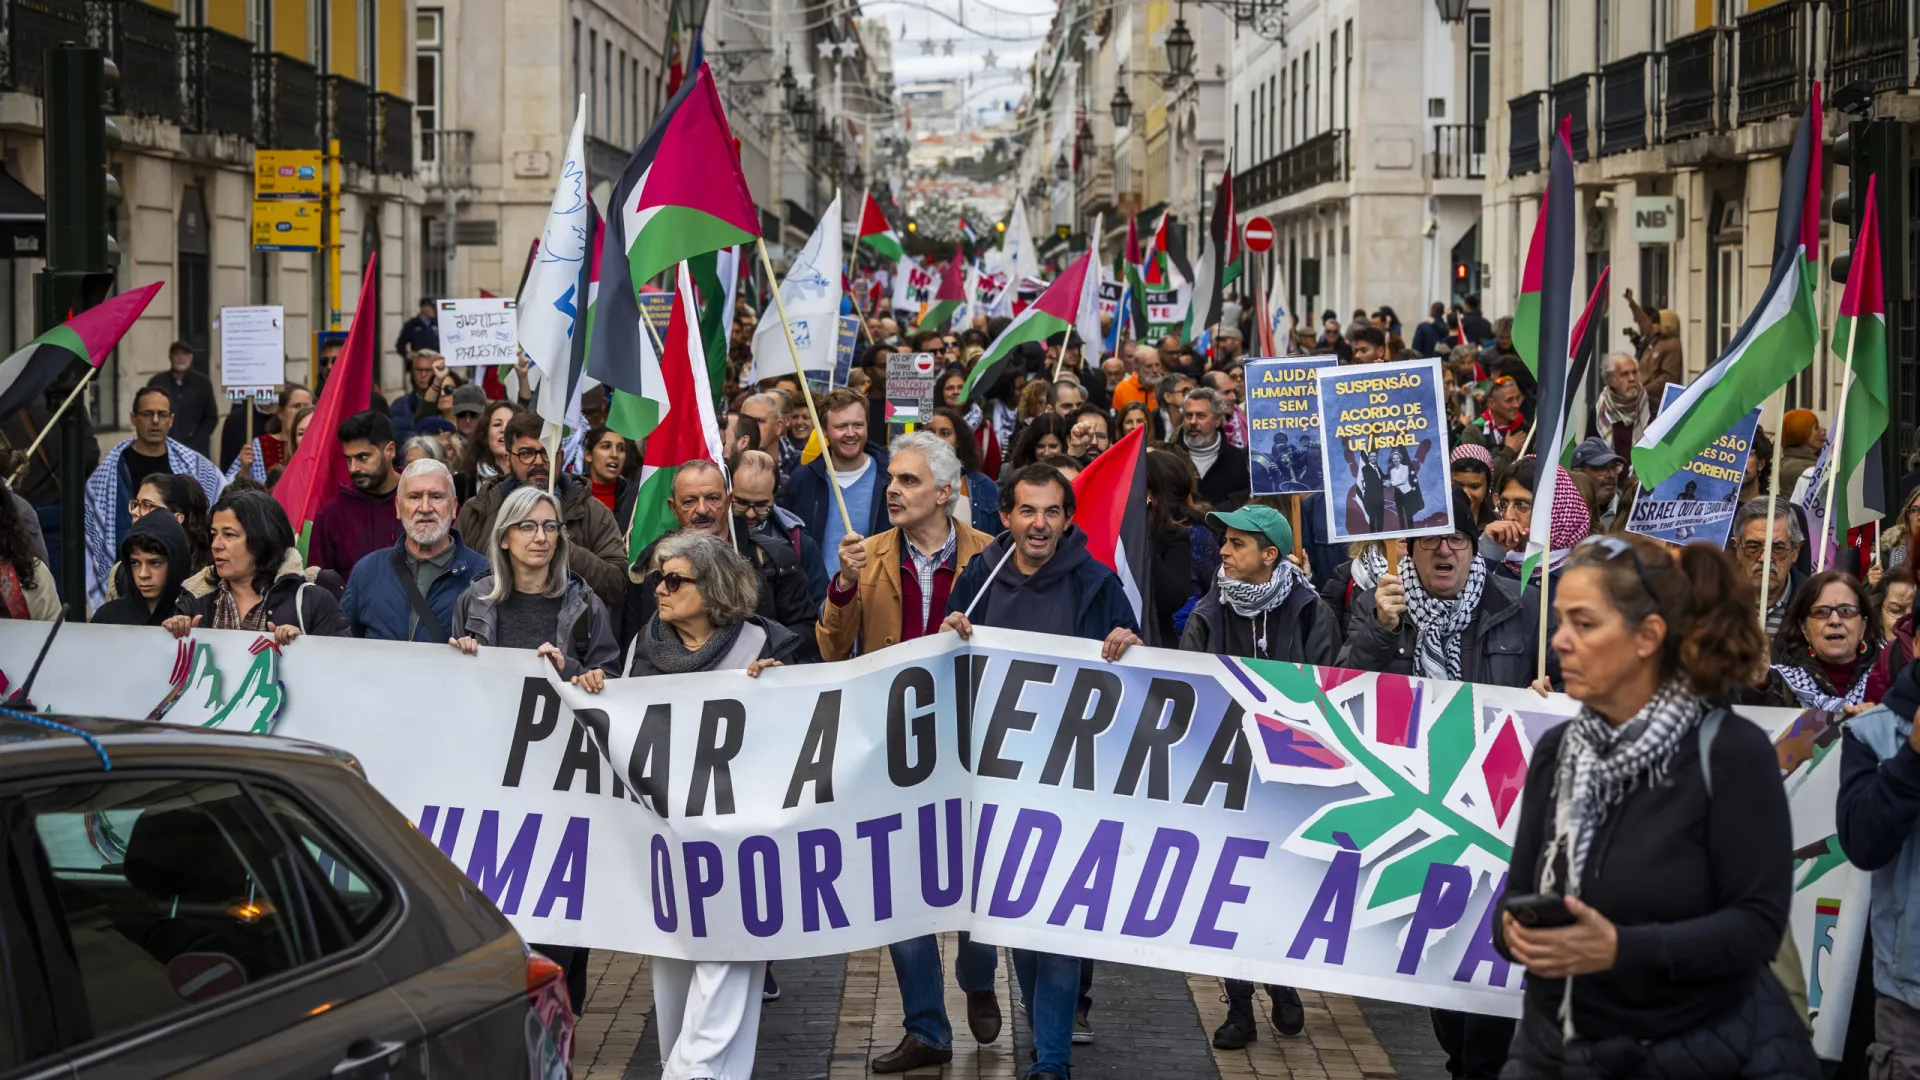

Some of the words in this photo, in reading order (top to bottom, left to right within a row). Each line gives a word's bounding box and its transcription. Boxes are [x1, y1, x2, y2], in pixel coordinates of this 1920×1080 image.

[1636, 210, 1667, 229] NB
[453, 312, 511, 329] JUSTICE
[471, 329, 488, 338] FOR
[455, 344, 516, 360] PALESTINE
[1263, 368, 1317, 383] AJUDA
[1335, 373, 1421, 395] SUSPENSÃO
[1251, 381, 1318, 399] HUMANITÁ
[1369, 393, 1388, 405] DO
[1279, 400, 1308, 412] SEM
[1339, 405, 1400, 422] ACORDO
[1403, 402, 1422, 416] DE
[1335, 415, 1428, 438] ASSOCIAÇÃO
[1698, 447, 1717, 459] ES
[1718, 452, 1736, 464] DO
[1692, 461, 1742, 483] ORIENTE
[1631, 501, 1676, 521] ISRAEL
[1678, 501, 1696, 517] OUT
[1695, 502, 1705, 516] OF
[1659, 521, 1675, 530] THE
[782, 689, 842, 810] A
[887, 654, 1253, 812] GUERRA
[651, 798, 1269, 950] OPORTUIDADE
[1286, 831, 1361, 966] À
[1396, 862, 1527, 990] PA
